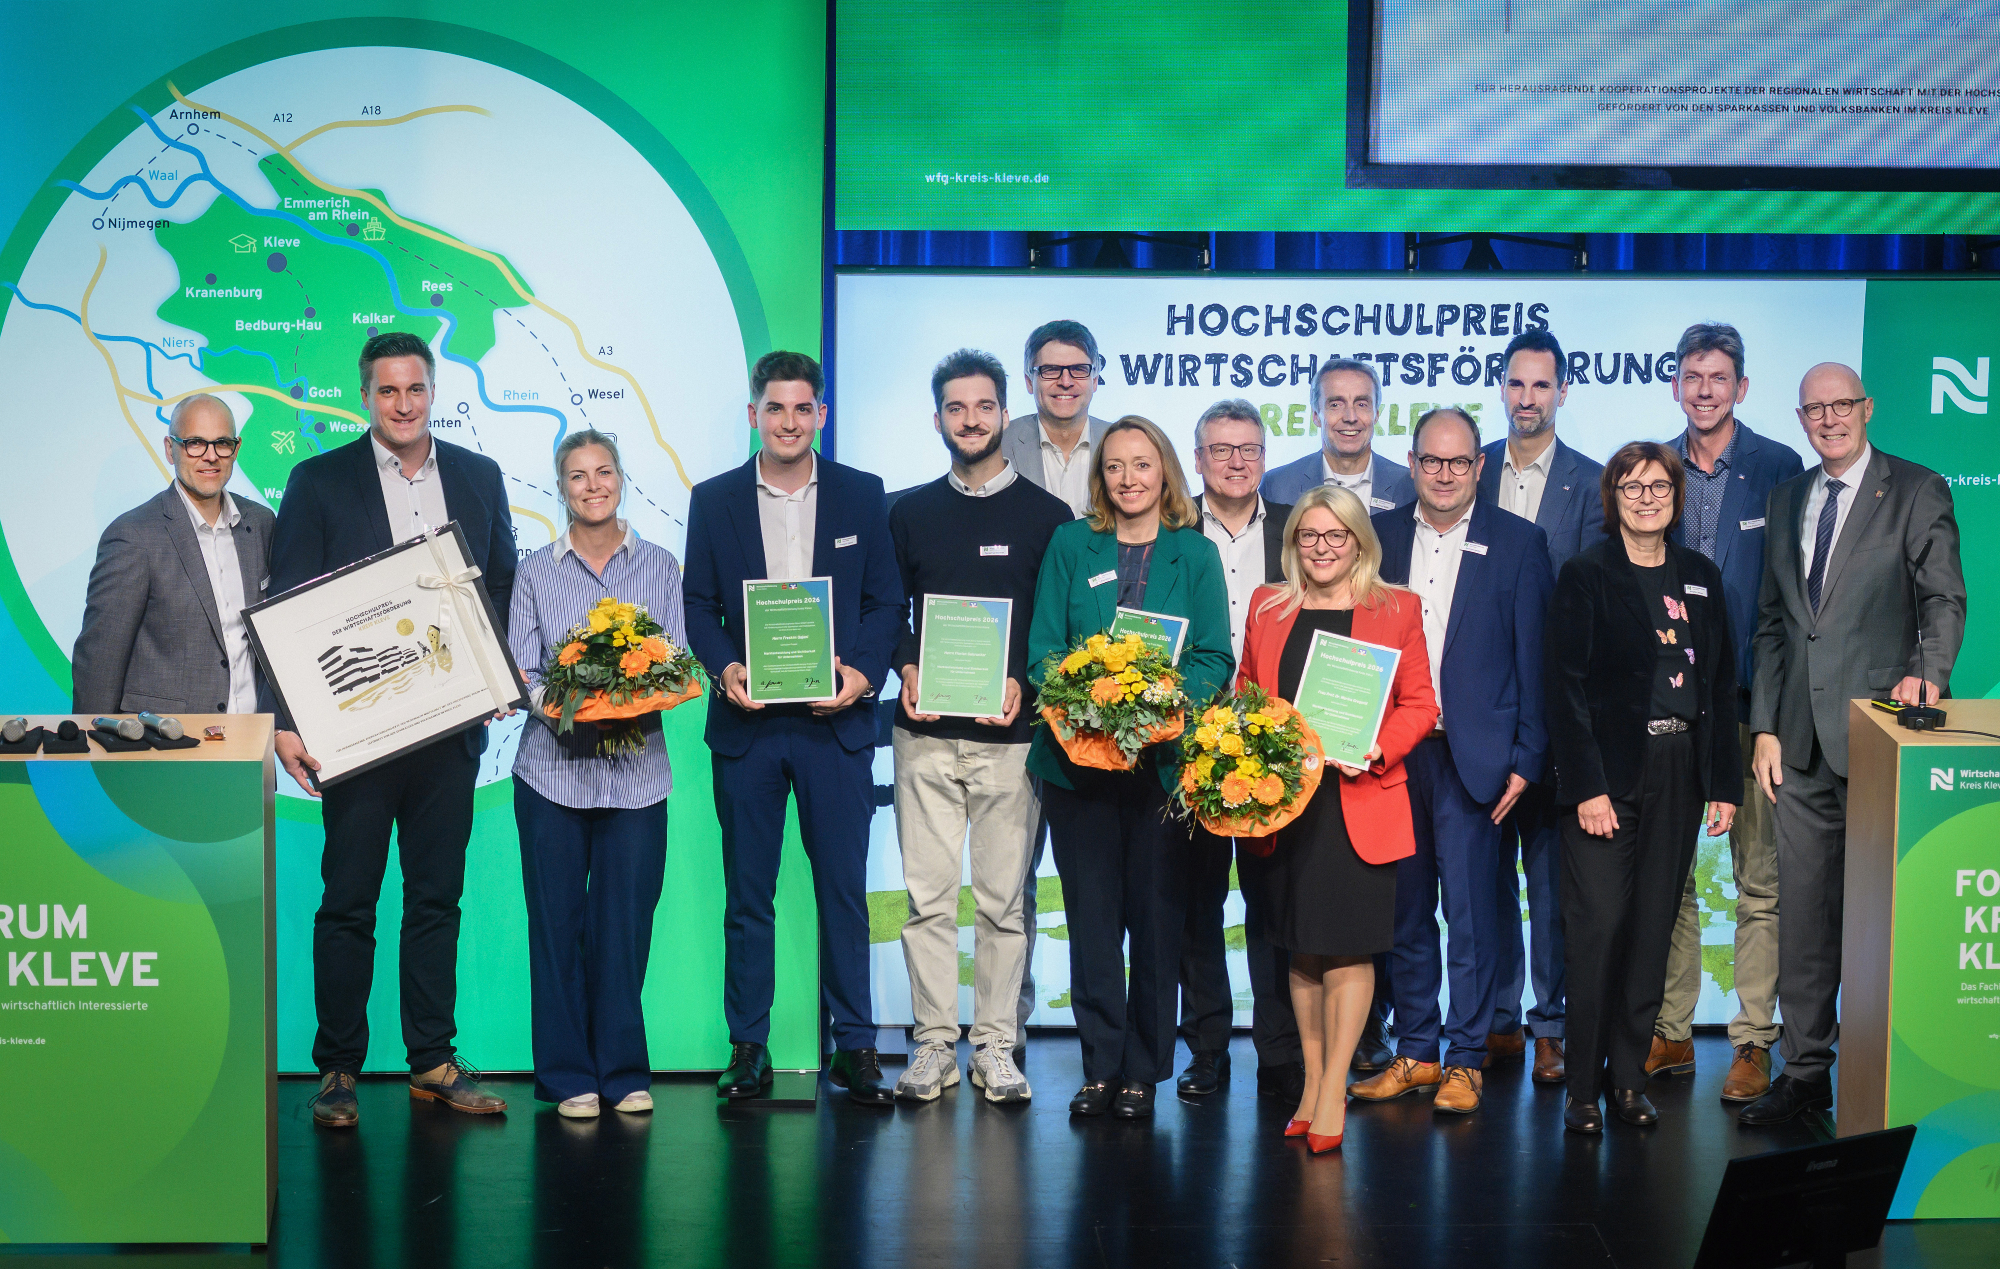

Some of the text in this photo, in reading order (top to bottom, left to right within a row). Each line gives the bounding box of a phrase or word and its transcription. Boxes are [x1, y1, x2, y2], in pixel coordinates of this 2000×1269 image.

[1500, 83, 1596, 94] HERAUSRAGENDE
[1600, 84, 1742, 96] KOOPERATIONSPROJEKTE
[1744, 85, 1766, 96] DER
[1769, 86, 1839, 97] REGIONALEN
[1842, 87, 1913, 97] WIRTSCHAFT
[1917, 87, 1937, 98] MIT
[1940, 88, 1961, 98] DER
[169, 108, 221, 121] Arnhem
[361, 105, 382, 116] A18
[1665, 102, 1688, 113] VON
[1692, 102, 1713, 113] DEN
[1717, 103, 1790, 114] SPARKASSEN
[1793, 104, 1816, 114] UND
[1819, 104, 1900, 115] VOLKSBANKEN
[1904, 105, 1916, 115] IM
[1920, 105, 1952, 116] KREIS
[1955, 106, 1989, 116] KLEVE
[273, 113, 293, 123] A12
[148, 169, 178, 182] Waal
[924, 171, 1050, 186] wfg-kreis-kleve.de
[283, 197, 350, 209] Emmerich
[308, 208, 370, 221] am Rhein
[107, 217, 170, 231] Nijmegen
[263, 236, 301, 248] Kleve
[421, 280, 453, 293] Rees
[185, 286, 263, 300] Kranenburg
[352, 312, 395, 324] Kalkar
[1166, 302, 1551, 337] HOCHSCHULPREIS
[235, 319, 322, 333] Bedburg-Hau
[162, 337, 195, 348] Niers
[598, 345, 614, 356] A3
[308, 386, 342, 398] Goch
[503, 389, 539, 401] Rhein
[588, 388, 625, 400] Wesel
[329, 421, 371, 433] Weeze
[755, 598, 803, 606] Hochschulpreis
[934, 614, 982, 623] Hochschulpreis
[1959, 781, 1982, 790] Kreis
[8, 951, 159, 987] KLEVE
[1961, 982, 2000, 991] Das Fach
[1, 1000, 149, 1011] wirtschaftlich Interessierte
